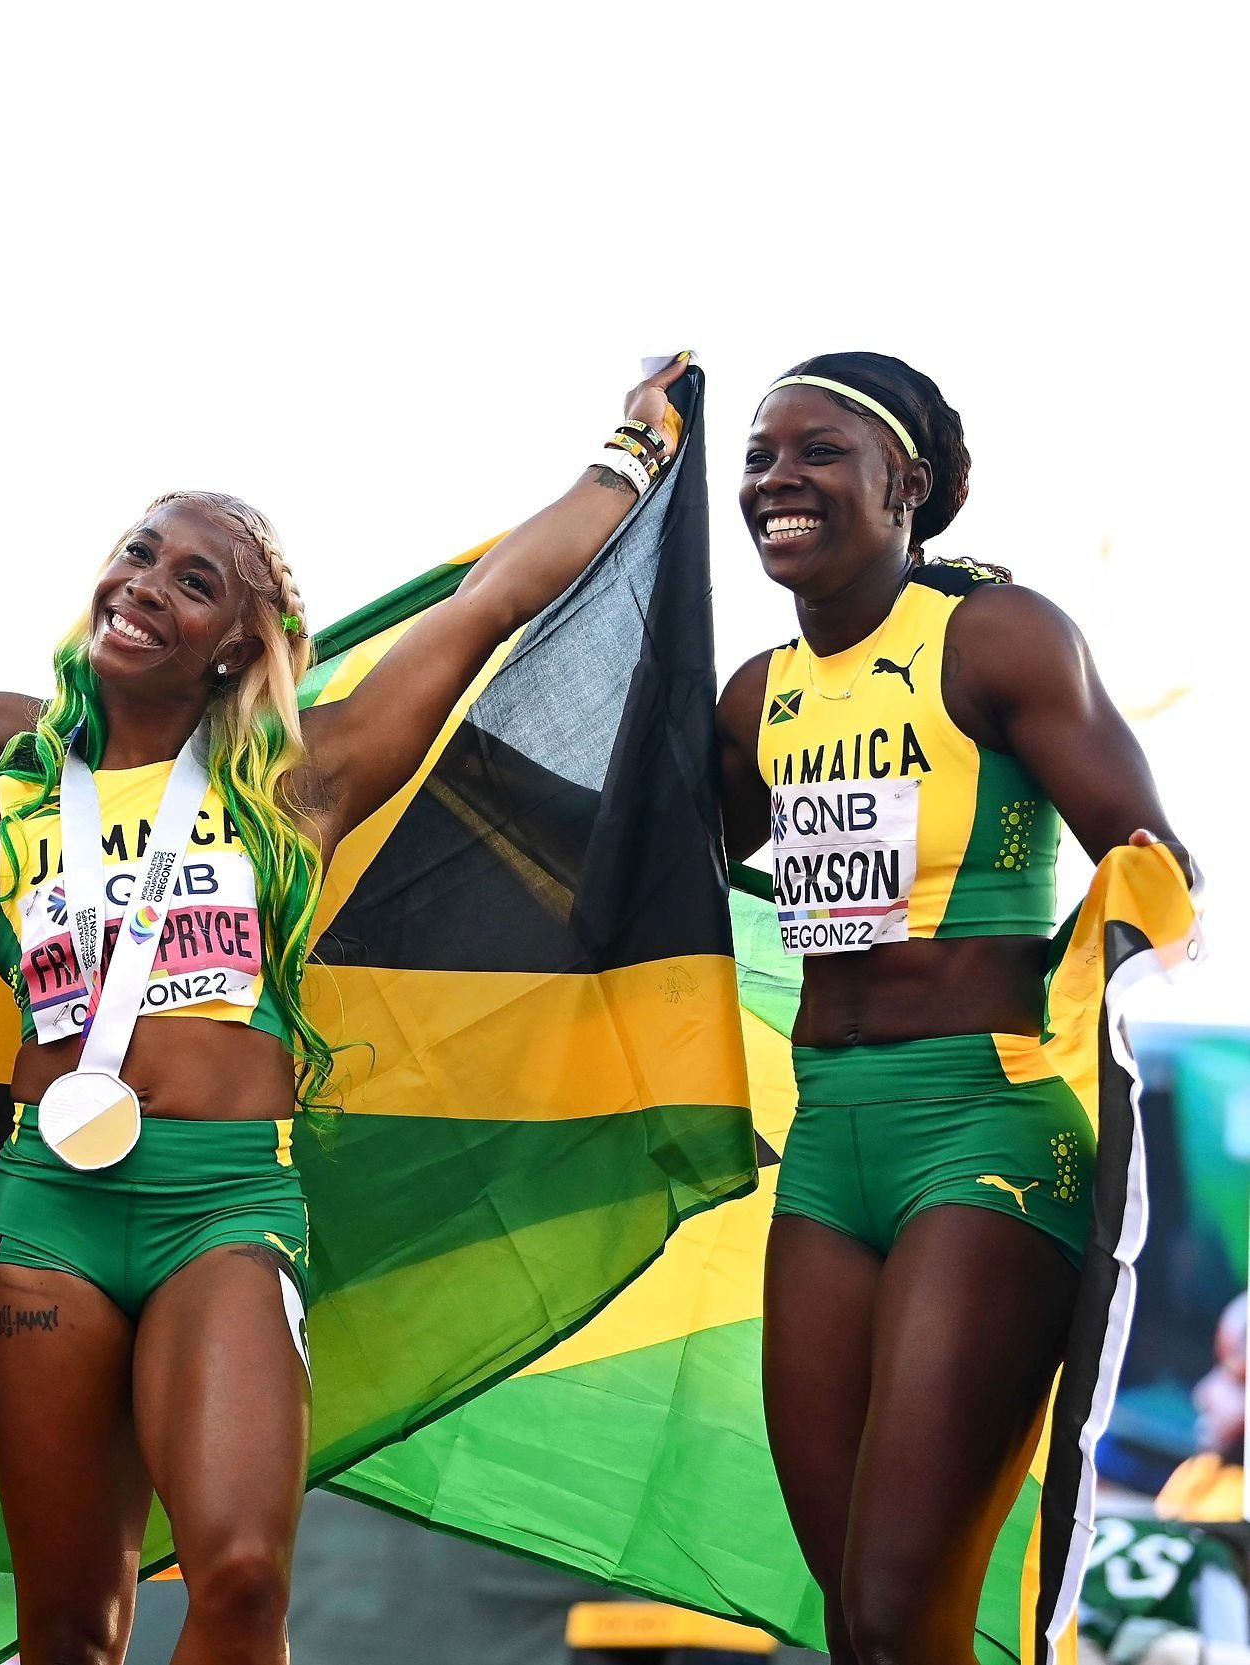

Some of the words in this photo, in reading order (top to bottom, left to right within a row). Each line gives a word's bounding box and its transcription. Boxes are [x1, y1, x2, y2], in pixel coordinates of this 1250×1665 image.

[792, 792, 878, 836] QNB
[105, 863, 219, 906] QB
[773, 849, 900, 906] ACKSON
[780, 921, 874, 949] REGON22
[70, 972, 227, 1027] OON22
